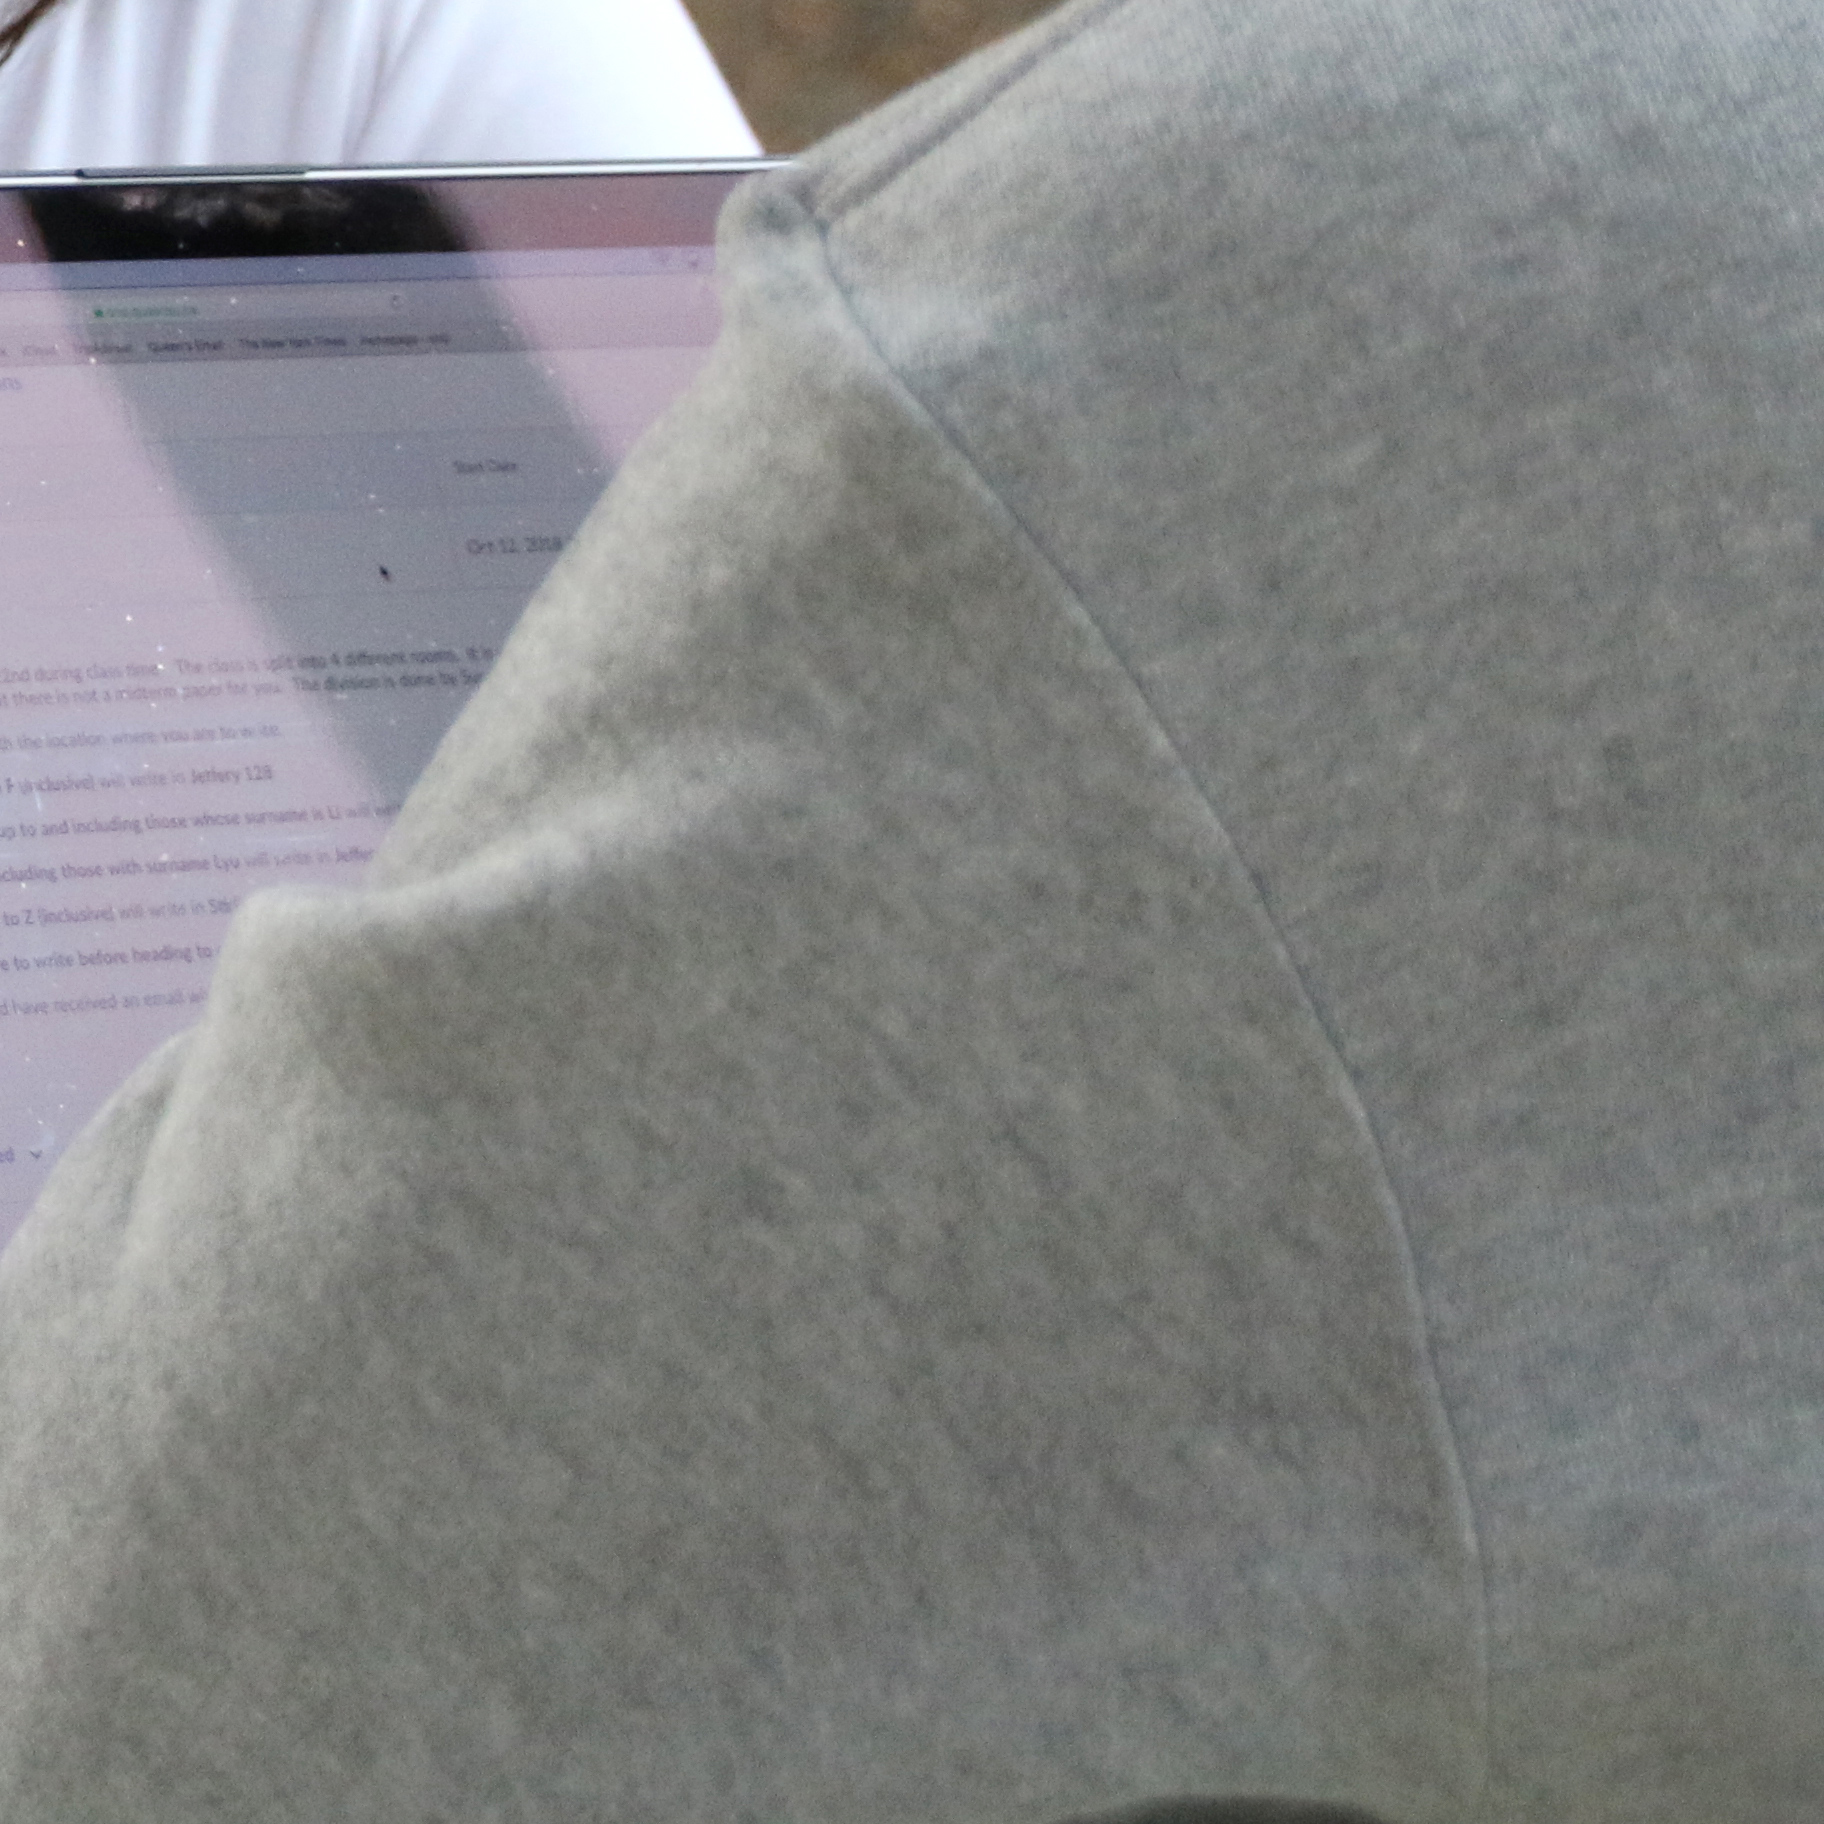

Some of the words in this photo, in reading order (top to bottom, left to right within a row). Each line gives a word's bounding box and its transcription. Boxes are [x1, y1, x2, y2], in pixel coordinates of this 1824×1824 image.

[33, 665, 83, 684] during
[10, 690, 56, 706] there
[15, 734, 43, 750] the
[18, 822, 37, 837] to
[40, 819, 70, 836] and
[72, 816, 140, 835] including
[144, 814, 188, 830] those
[61, 863, 104, 879] those
[107, 859, 143, 876] with
[2, 912, 20, 928] to
[20, 911, 35, 927] Z
[12, 954, 31, 970] to
[33, 951, 75, 969] write
[77, 949, 130, 966] before
[131, 944, 193, 963] heading
[11, 999, 50, 1015] have
